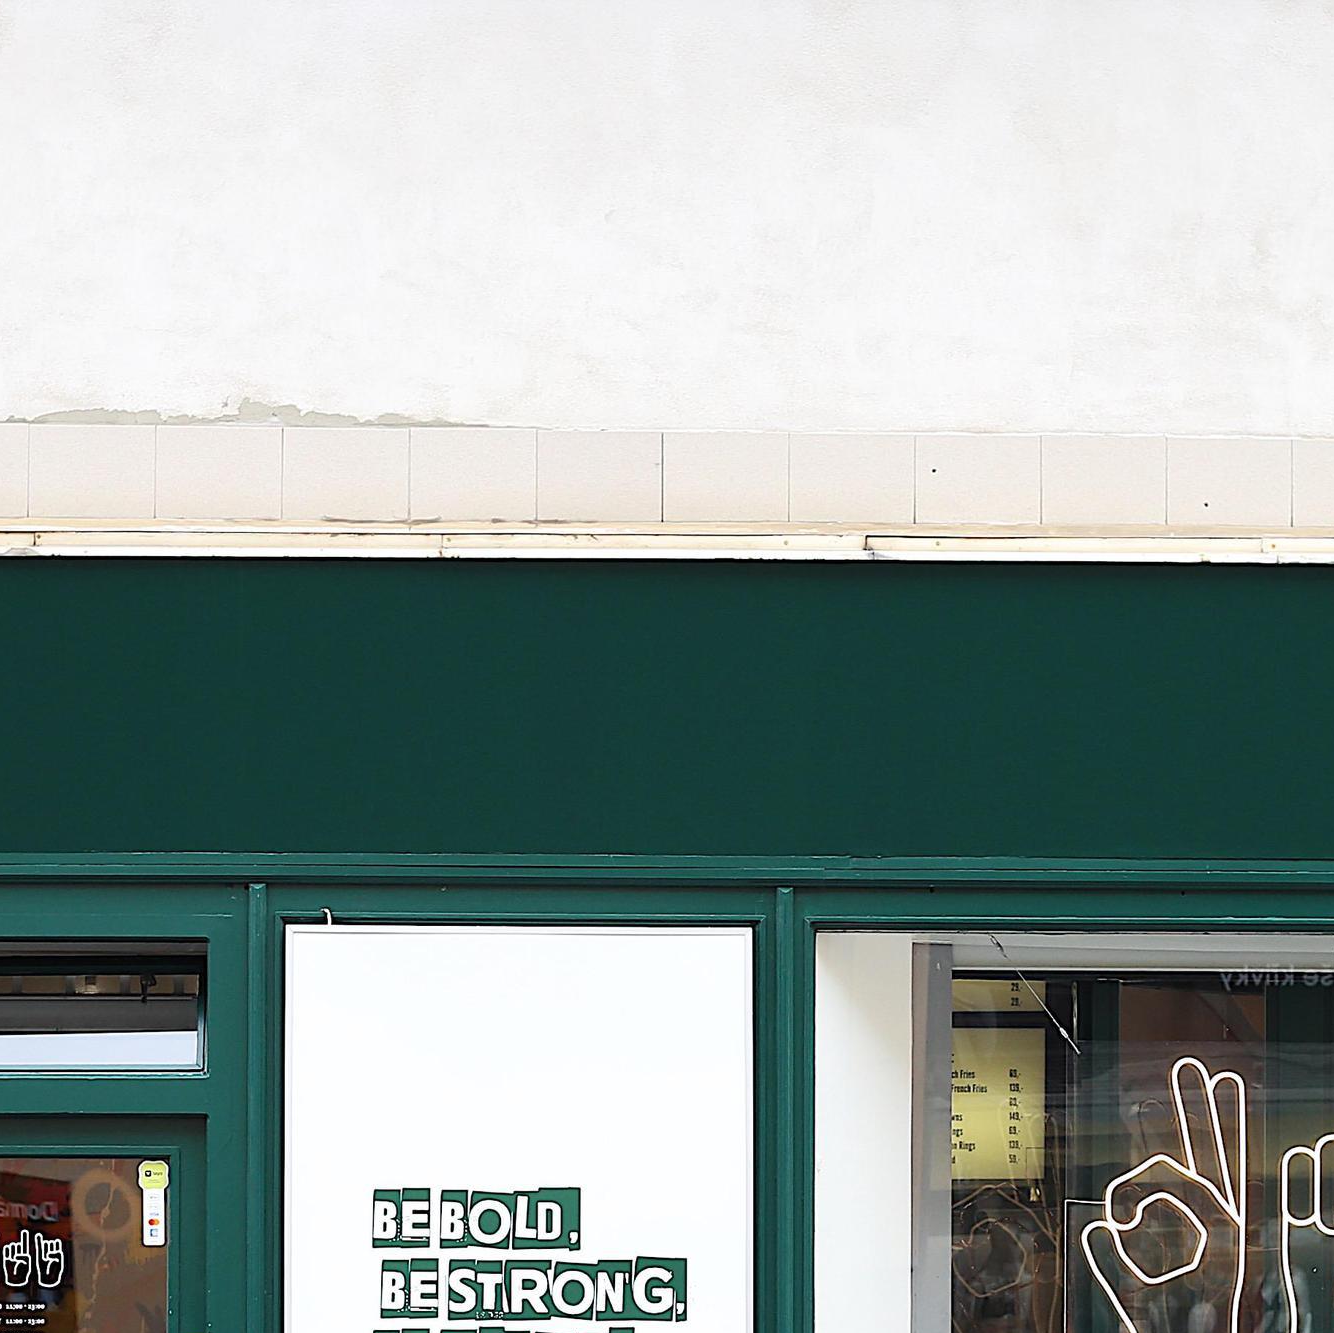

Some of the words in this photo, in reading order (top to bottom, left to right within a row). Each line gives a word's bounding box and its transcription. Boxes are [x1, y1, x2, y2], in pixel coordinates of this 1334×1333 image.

[372, 1199, 431, 1241] BE
[439, 1194, 580, 1246] BOLD,
[380, 1270, 439, 1312] BE
[447, 1266, 686, 1316] STRONG,
